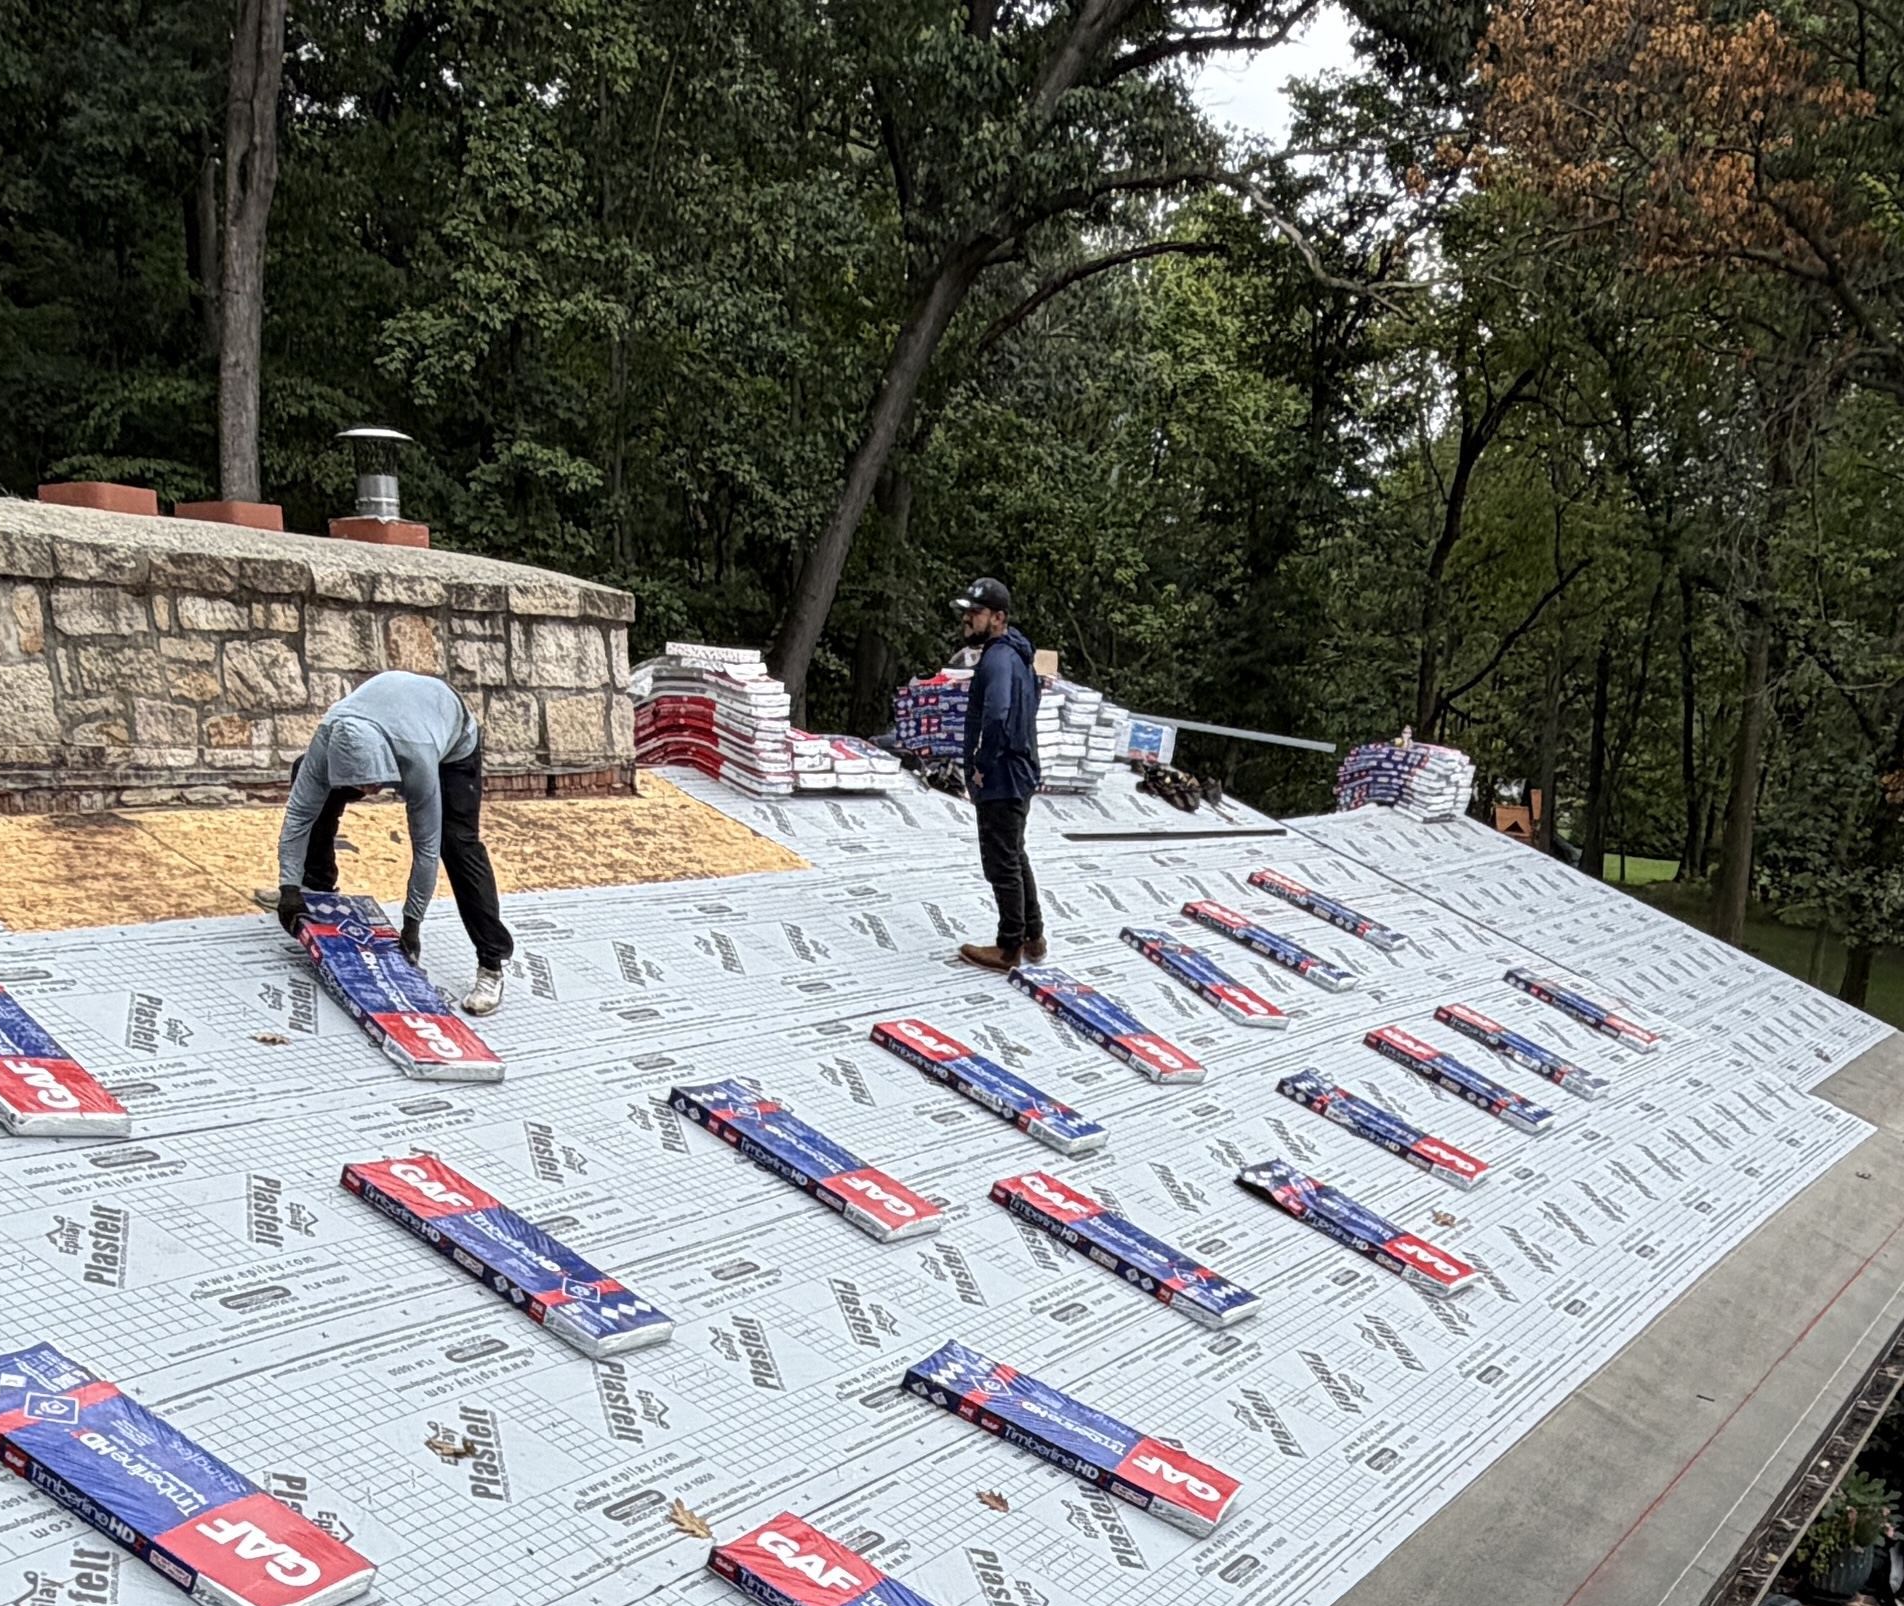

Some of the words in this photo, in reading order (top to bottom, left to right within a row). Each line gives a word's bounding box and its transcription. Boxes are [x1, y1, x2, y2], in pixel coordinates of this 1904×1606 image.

[405, 1016, 465, 1061] GAF
[896, 1023, 960, 1058] GAF
[2, 1059, 82, 1109] GAF
[389, 1163, 474, 1207] GAF
[843, 1177, 916, 1217] GAF
[1027, 1171, 1091, 1217] GAF
[85, 1205, 123, 1288] Plasfelt
[1395, 1239, 1460, 1278] GAF
[735, 1316, 784, 1390] Plasfelt
[600, 1361, 644, 1446] Plasfelt
[471, 1405, 493, 1500] Plasfelt
[1004, 1424, 1075, 1470] Timberline
[30, 1462, 108, 1529] Timberline
[107, 1446, 200, 1517] Timberline
[1131, 1454, 1221, 1501] GAF
[195, 1516, 321, 1587] GAF
[757, 1530, 862, 1591] GAF
